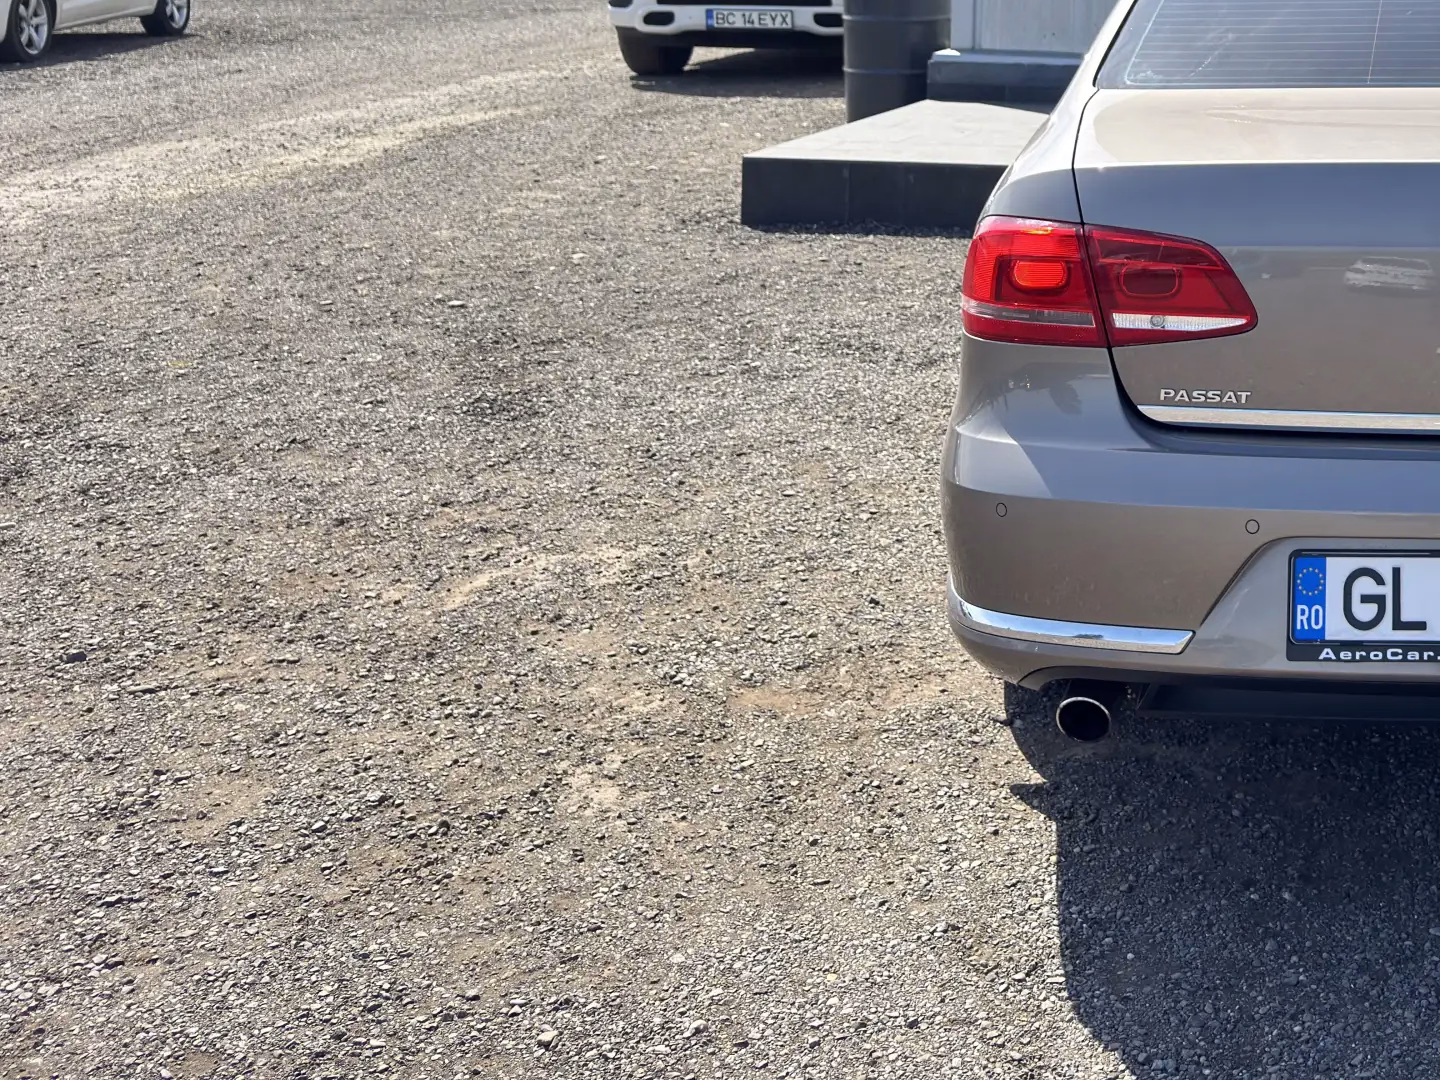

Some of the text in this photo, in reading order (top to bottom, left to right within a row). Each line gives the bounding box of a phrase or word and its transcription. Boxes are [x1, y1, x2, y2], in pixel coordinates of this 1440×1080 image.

[716, 12, 736, 25] BC
[742, 13, 755, 26] 14
[758, 13, 789, 26] EYX
[1160, 388, 1251, 404] PASSAT
[1343, 567, 1427, 631] GL
[1296, 604, 1323, 630] RO
